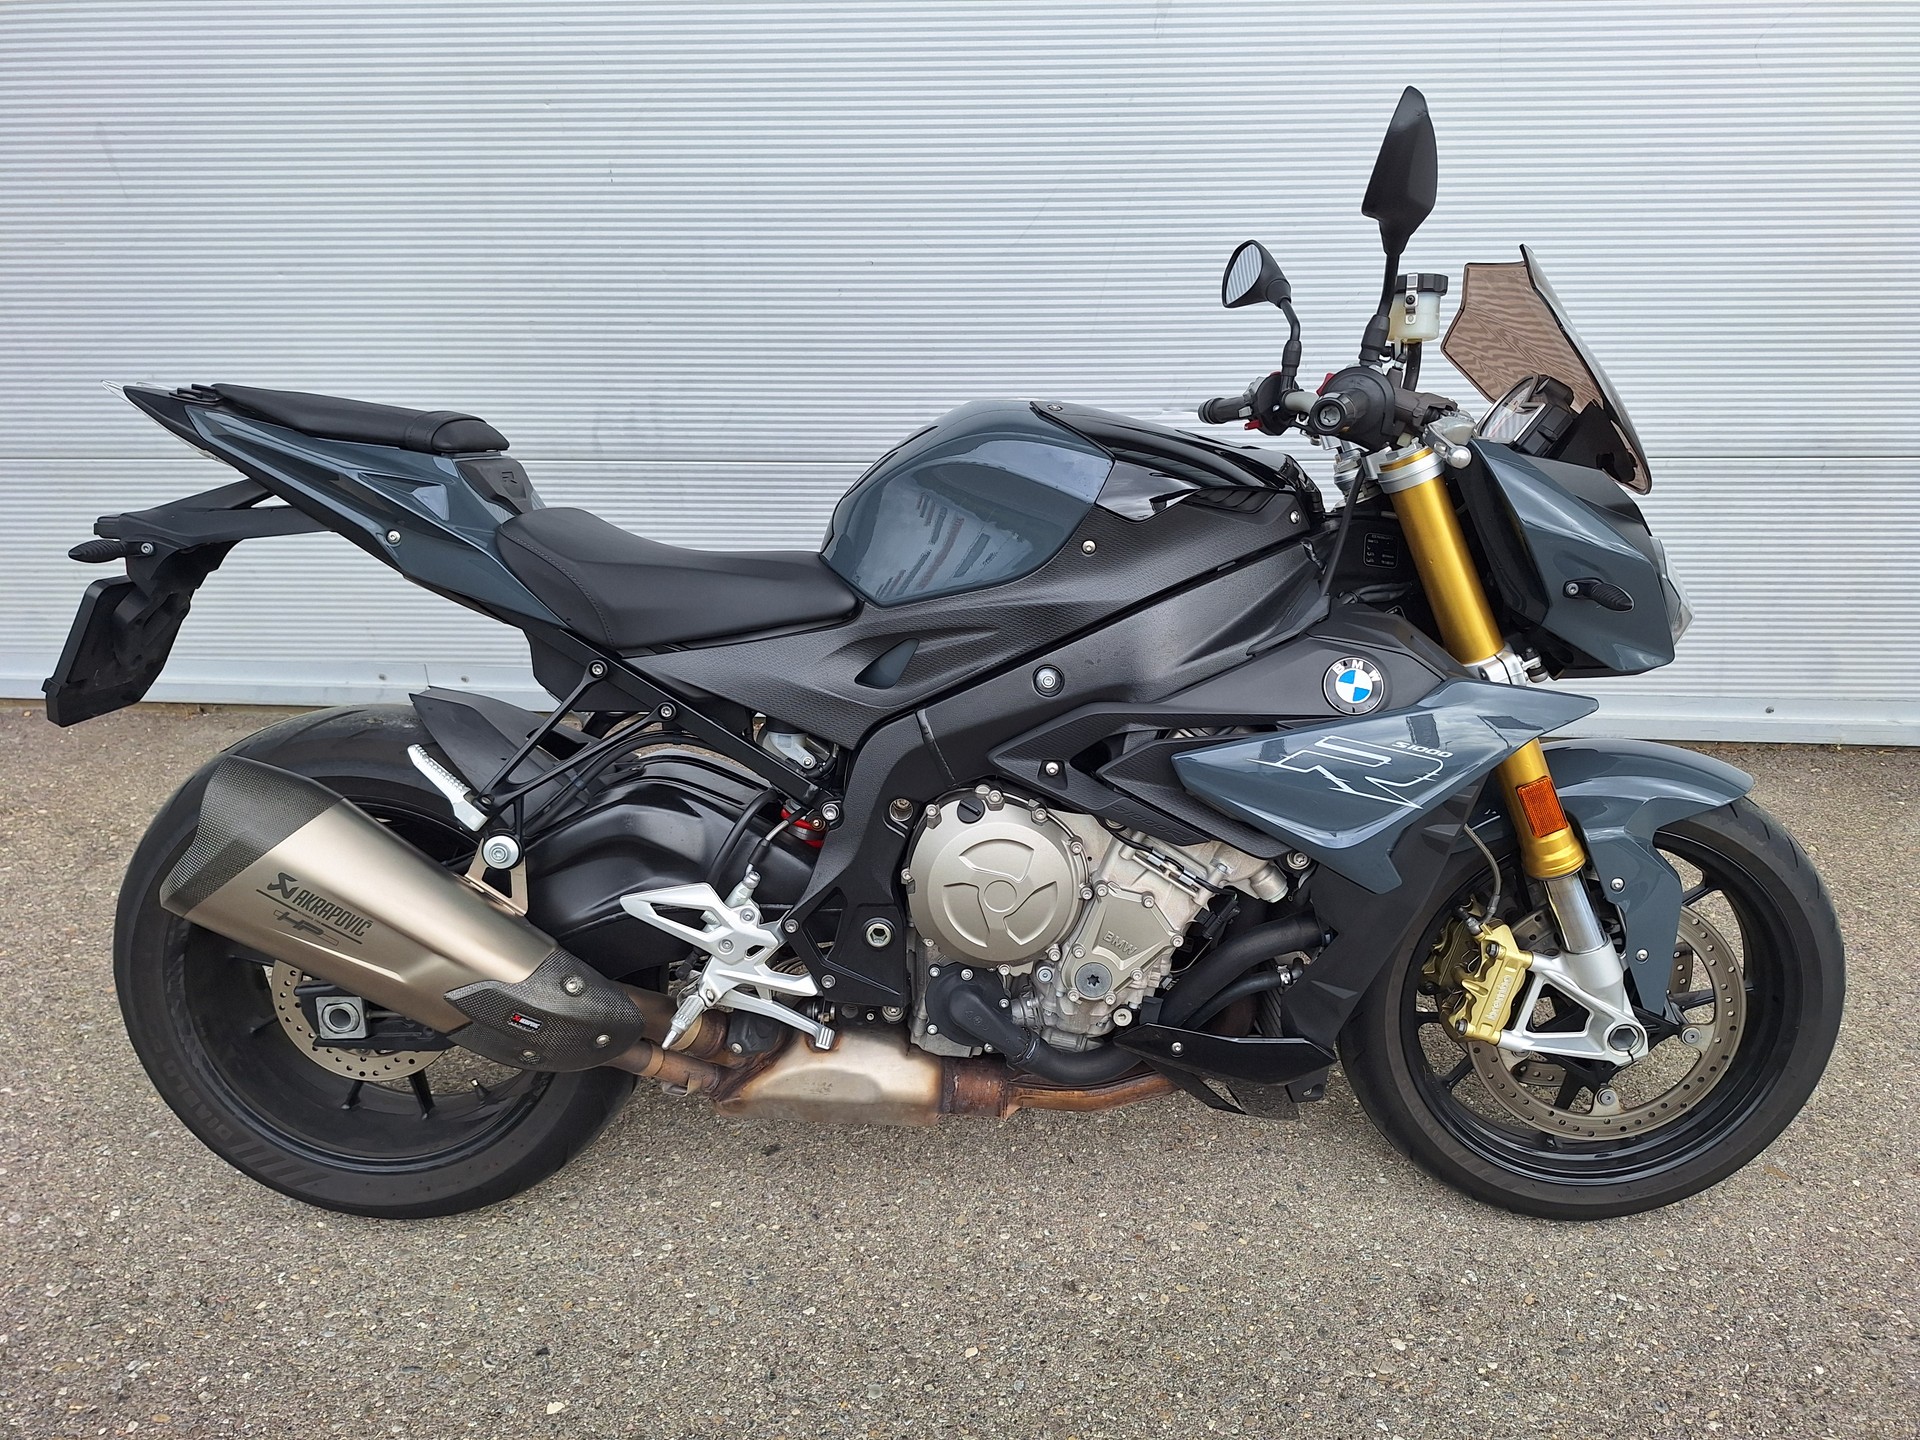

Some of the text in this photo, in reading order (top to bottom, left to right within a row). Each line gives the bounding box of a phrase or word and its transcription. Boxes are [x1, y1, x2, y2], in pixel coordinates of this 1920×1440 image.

[1332, 659, 1381, 682] BMW
[1391, 741, 1454, 758] S1000
[1103, 930, 1137, 955] BMW
[1484, 975, 1513, 1021] brembo
